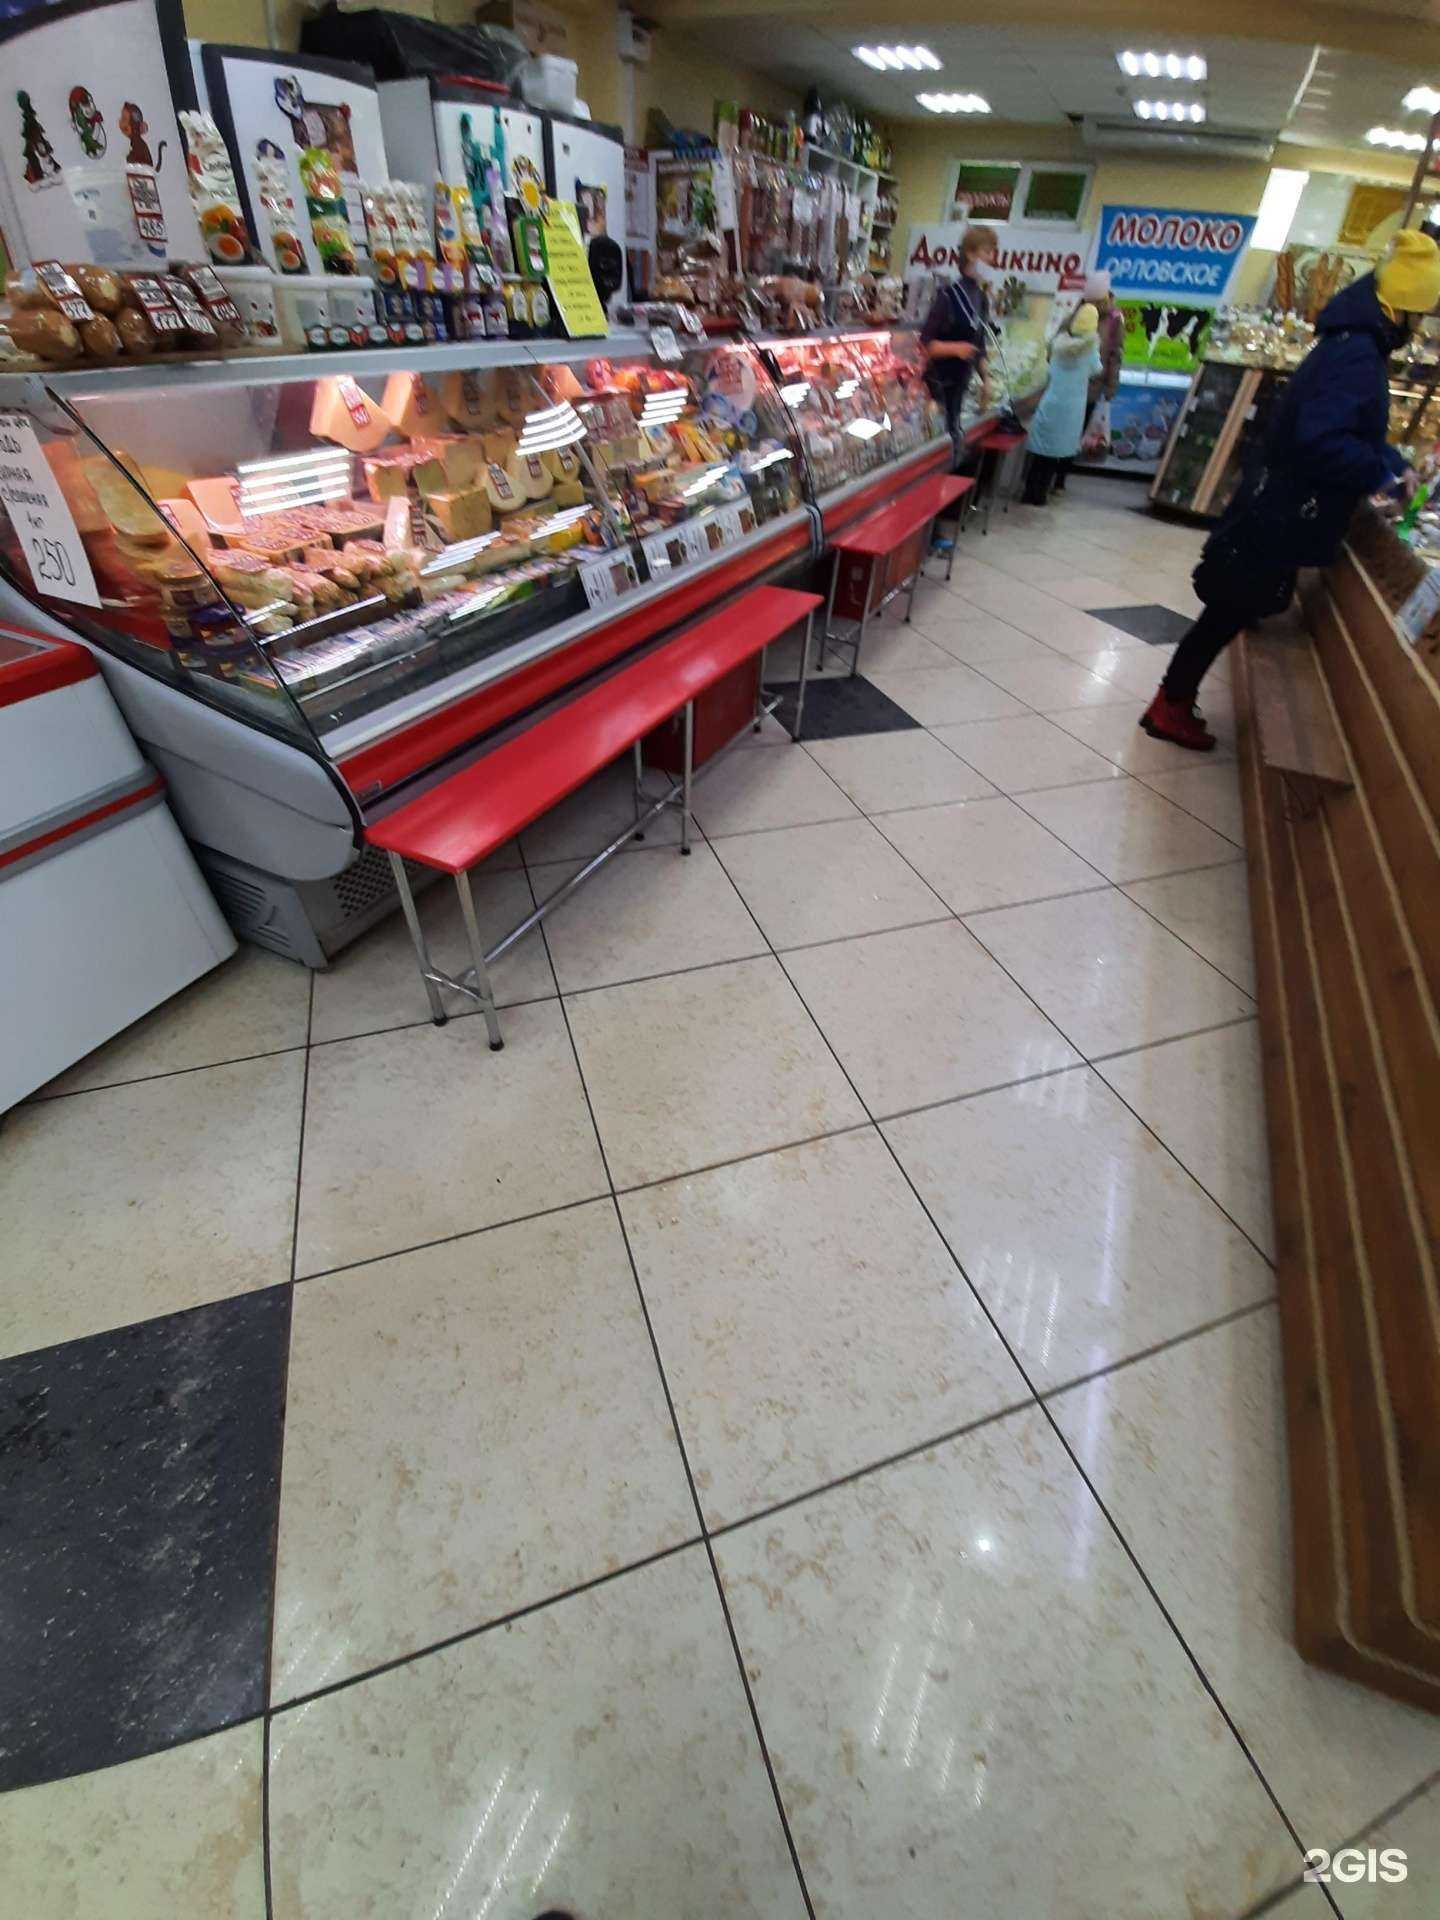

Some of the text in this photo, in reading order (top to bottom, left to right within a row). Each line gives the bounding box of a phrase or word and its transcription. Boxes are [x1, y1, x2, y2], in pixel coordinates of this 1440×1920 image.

[1108, 213, 1242, 252] МОЛОКО
[1105, 256, 1222, 286] ОРЛОВСКОЕ
[32, 537, 76, 587] 250
